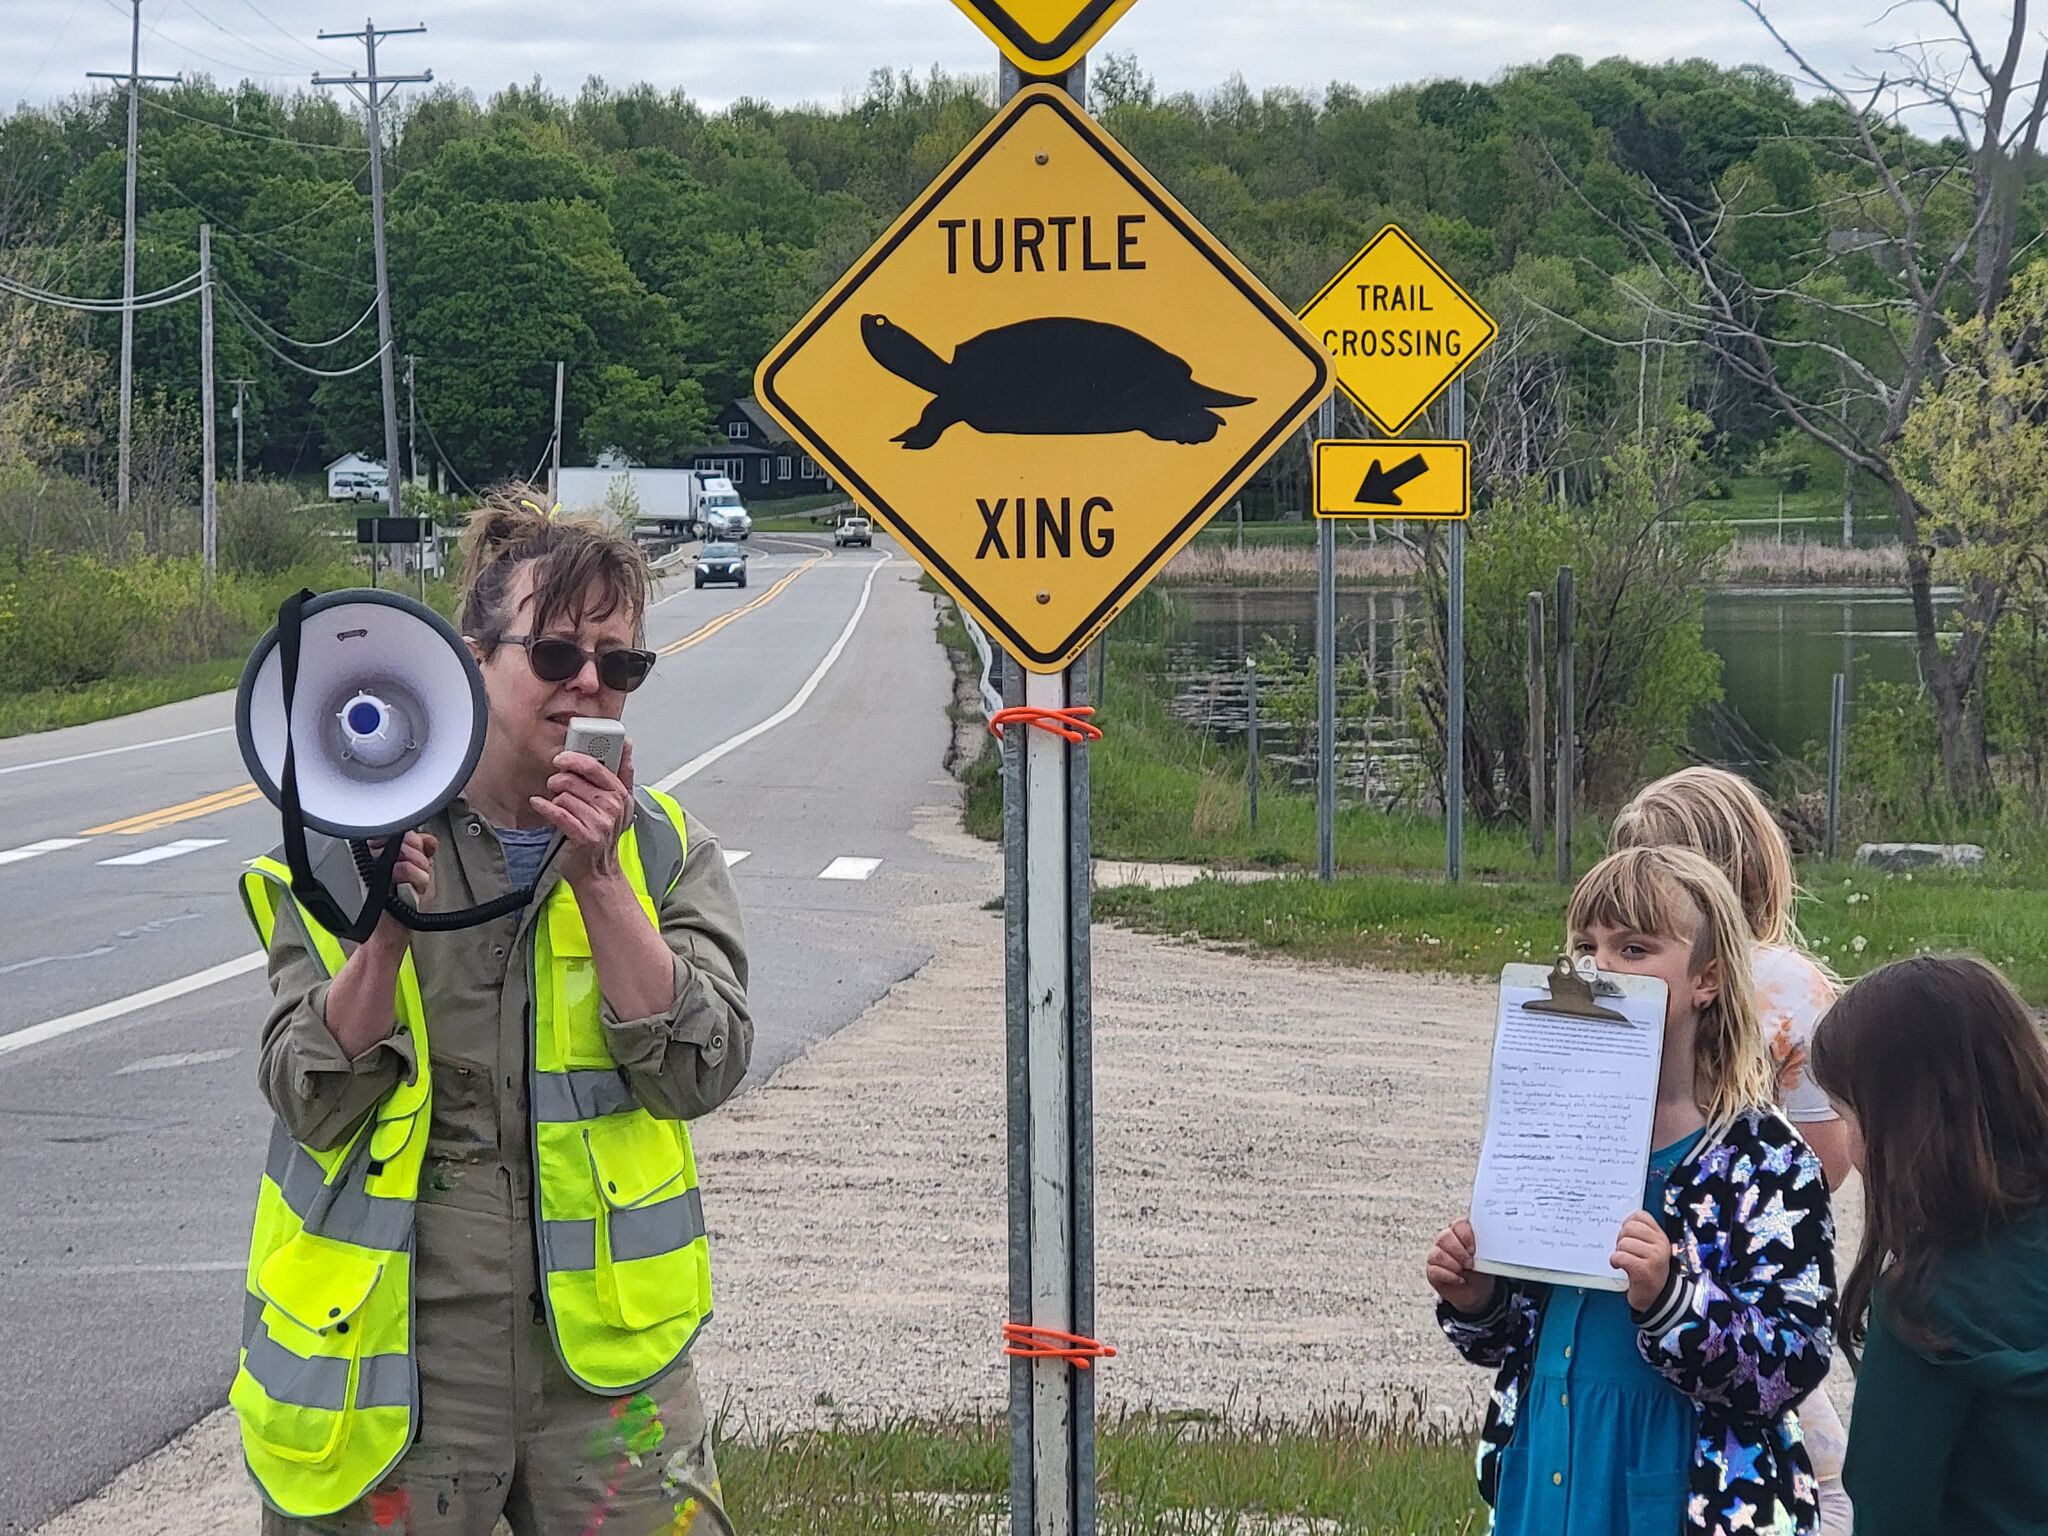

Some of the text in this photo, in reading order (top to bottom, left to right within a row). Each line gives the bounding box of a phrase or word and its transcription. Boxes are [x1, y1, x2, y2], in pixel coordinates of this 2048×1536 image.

[938, 214, 1147, 274] TURTLE
[1356, 284, 1434, 311] TRAIL
[1323, 329, 1461, 357] CROSSING
[975, 496, 1115, 559] XING
